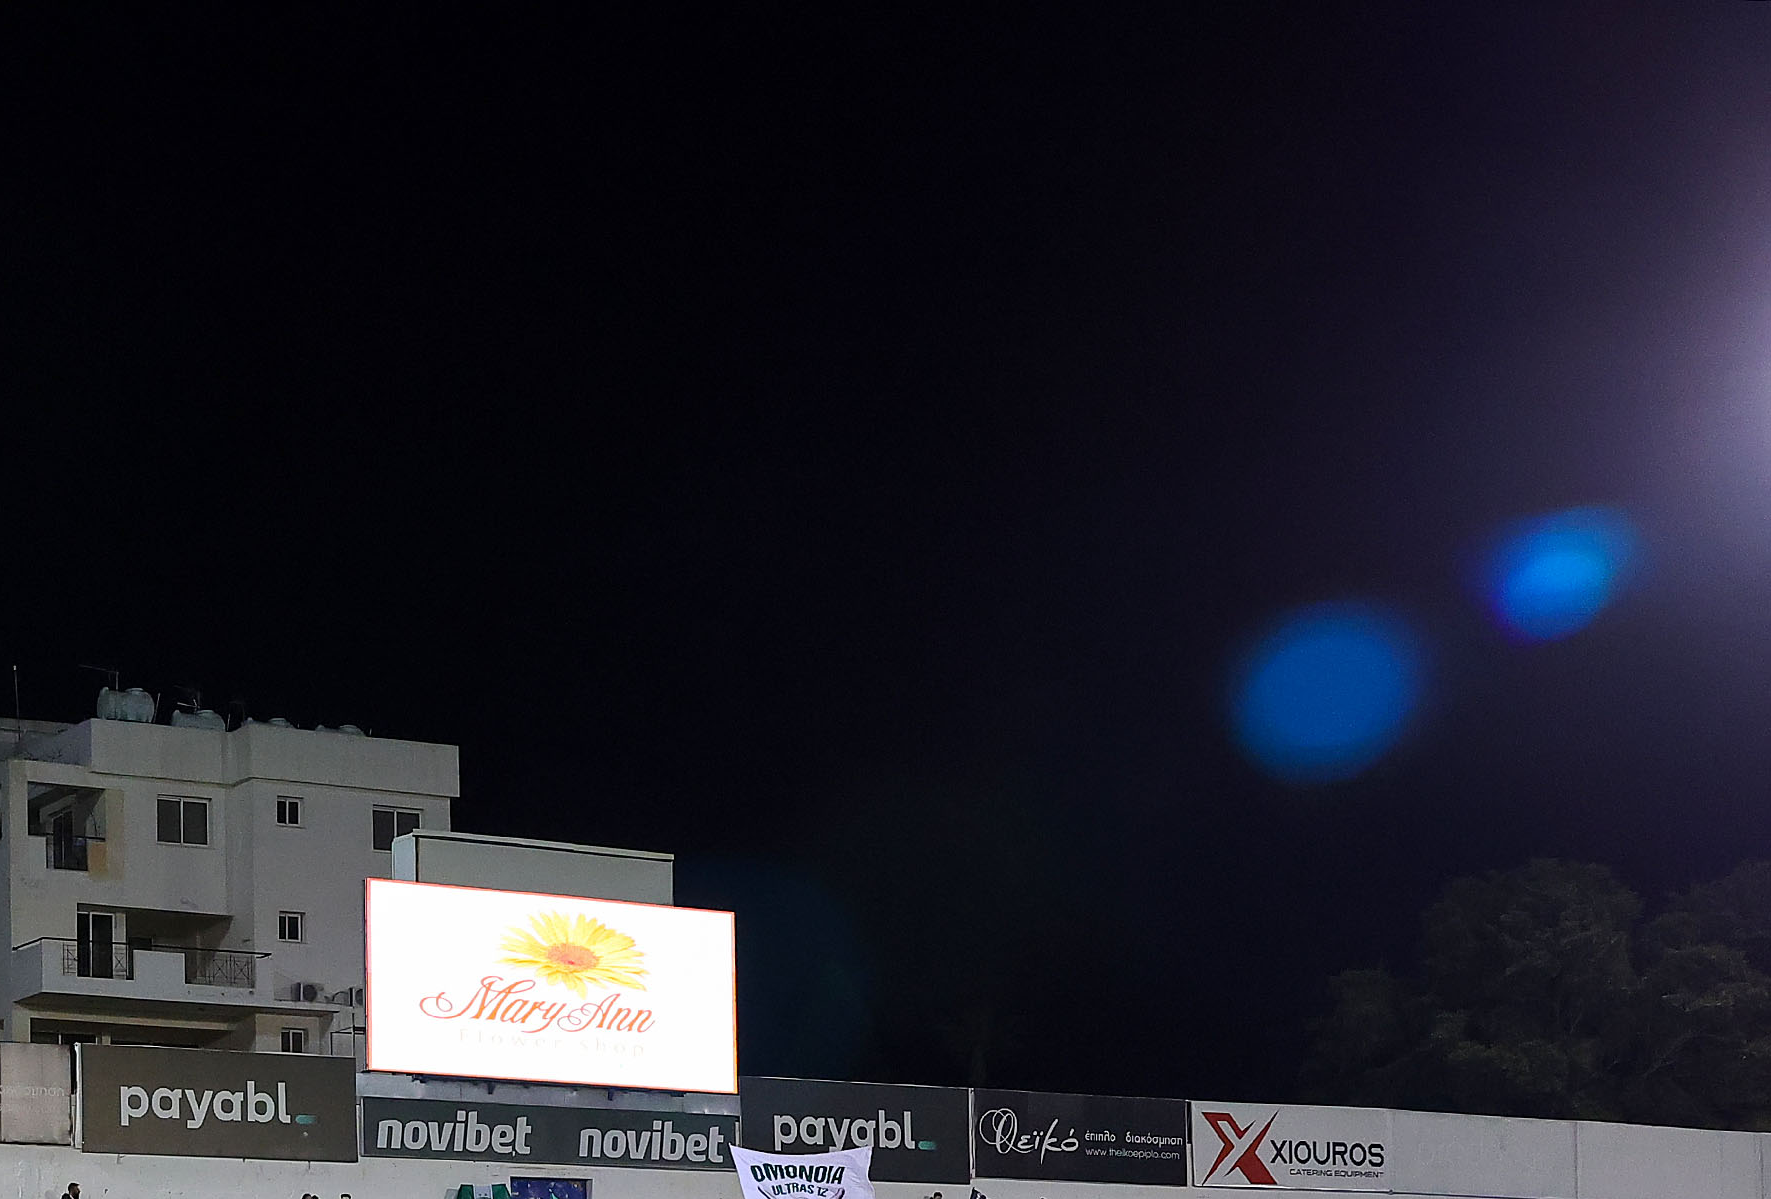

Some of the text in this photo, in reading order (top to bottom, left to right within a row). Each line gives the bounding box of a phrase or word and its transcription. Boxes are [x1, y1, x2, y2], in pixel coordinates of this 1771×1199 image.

[419, 975, 656, 1033] Mary Ann
[377, 1109, 725, 1163] novibet novibet
[1270, 1139, 1385, 1168] XIOUROS
[750, 1163, 846, 1185] OMONOIA
[1289, 1168, 1384, 1179] CATERING EQUIPMENT
[771, 1182, 815, 1196] ULTRAS
